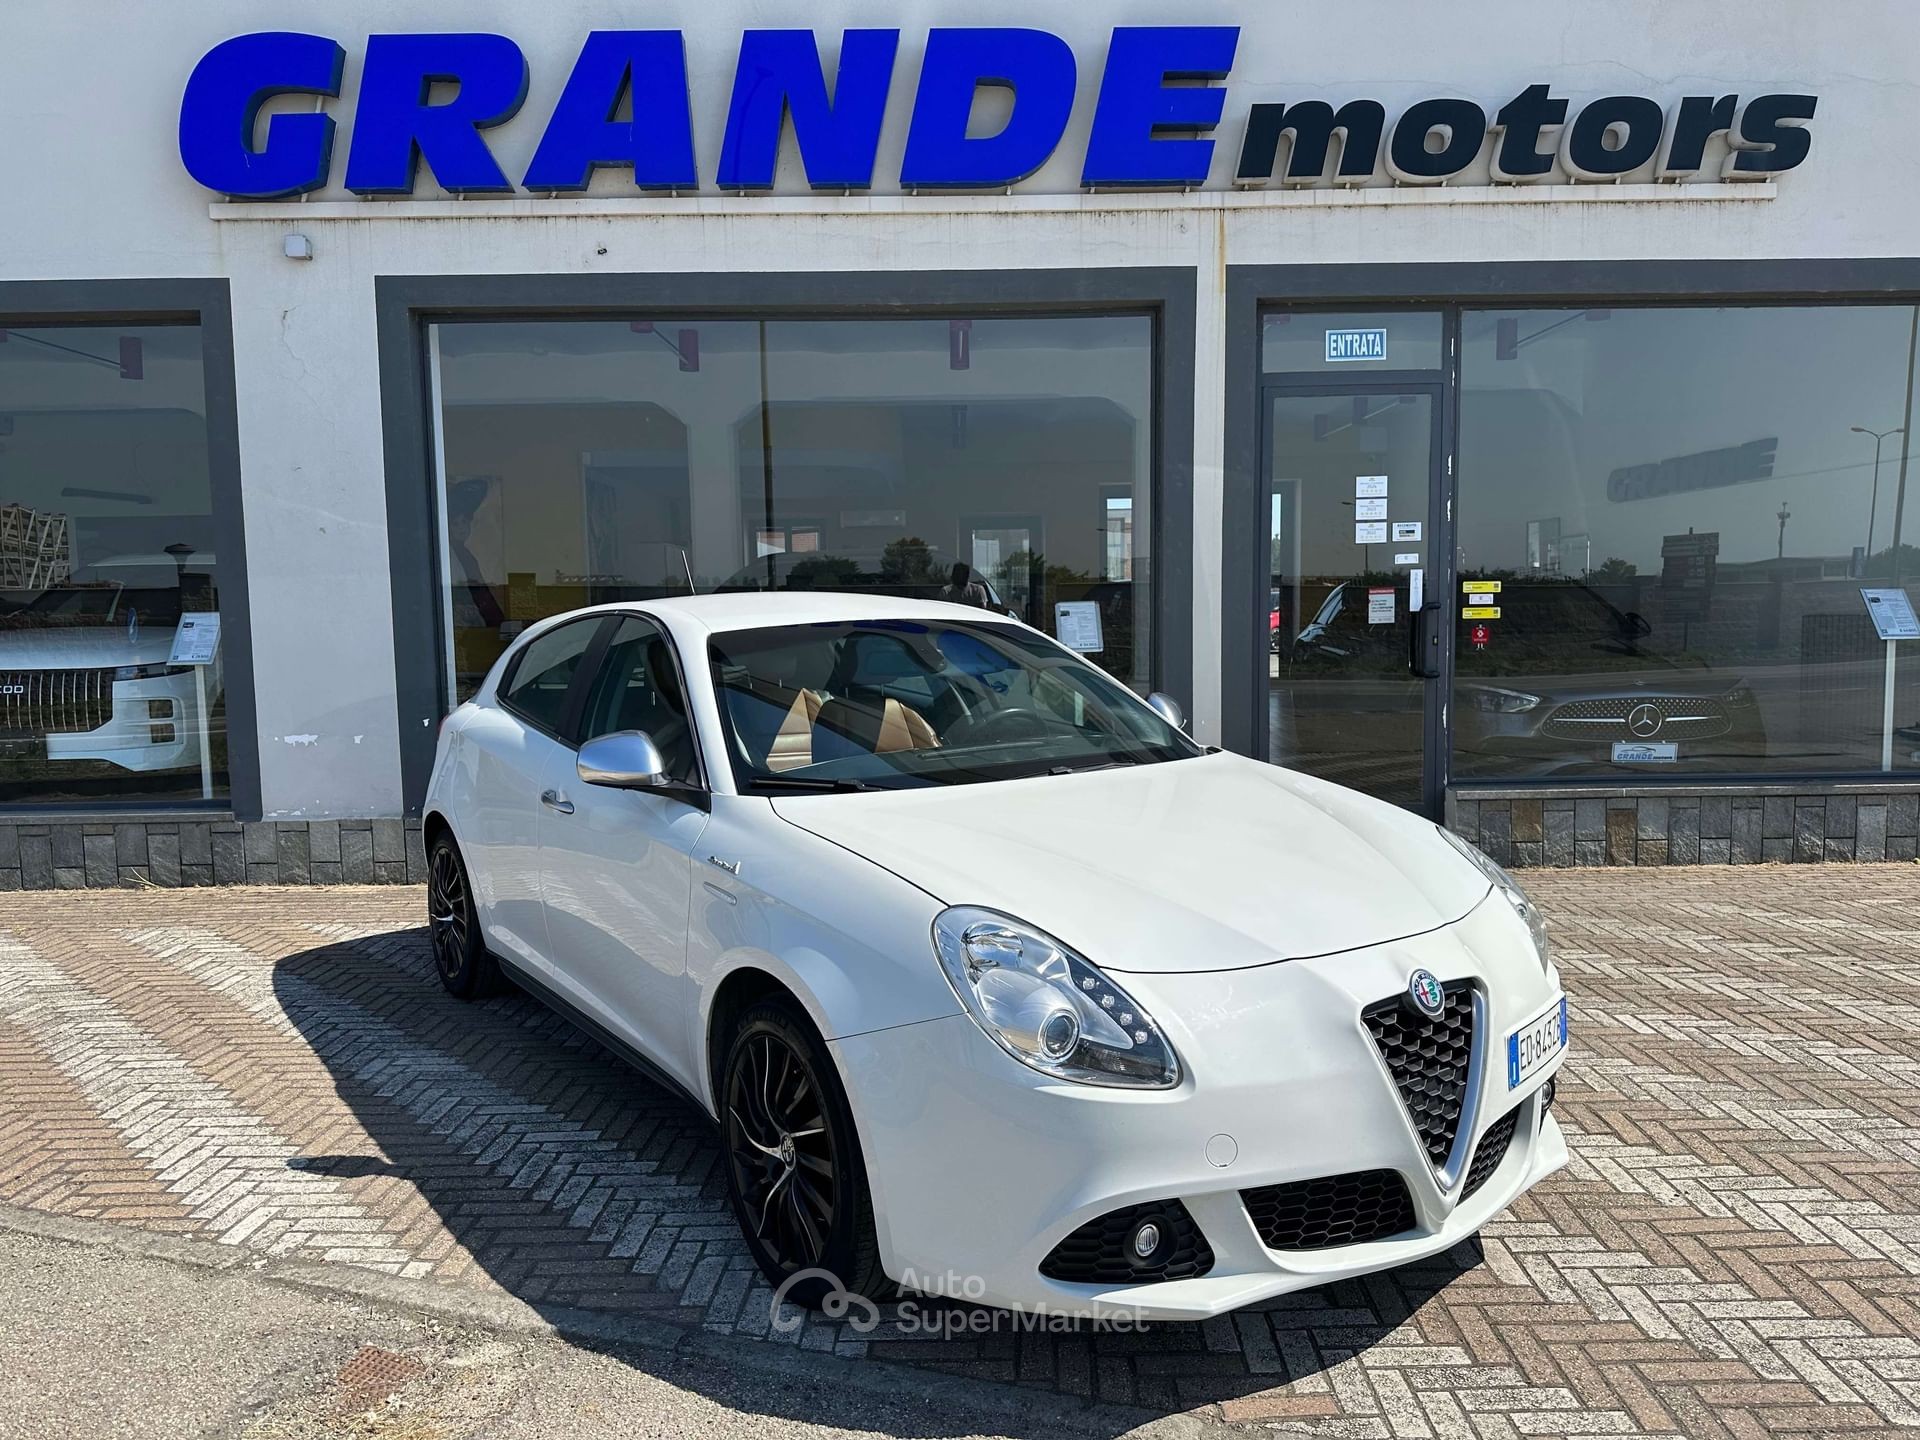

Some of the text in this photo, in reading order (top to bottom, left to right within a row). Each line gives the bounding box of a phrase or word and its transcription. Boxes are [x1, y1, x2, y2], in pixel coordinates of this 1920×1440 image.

[179, 26, 1818, 198] GRANDE motors
[1330, 333, 1382, 356] ENTRATA
[1616, 753, 1654, 761] GRANDE
